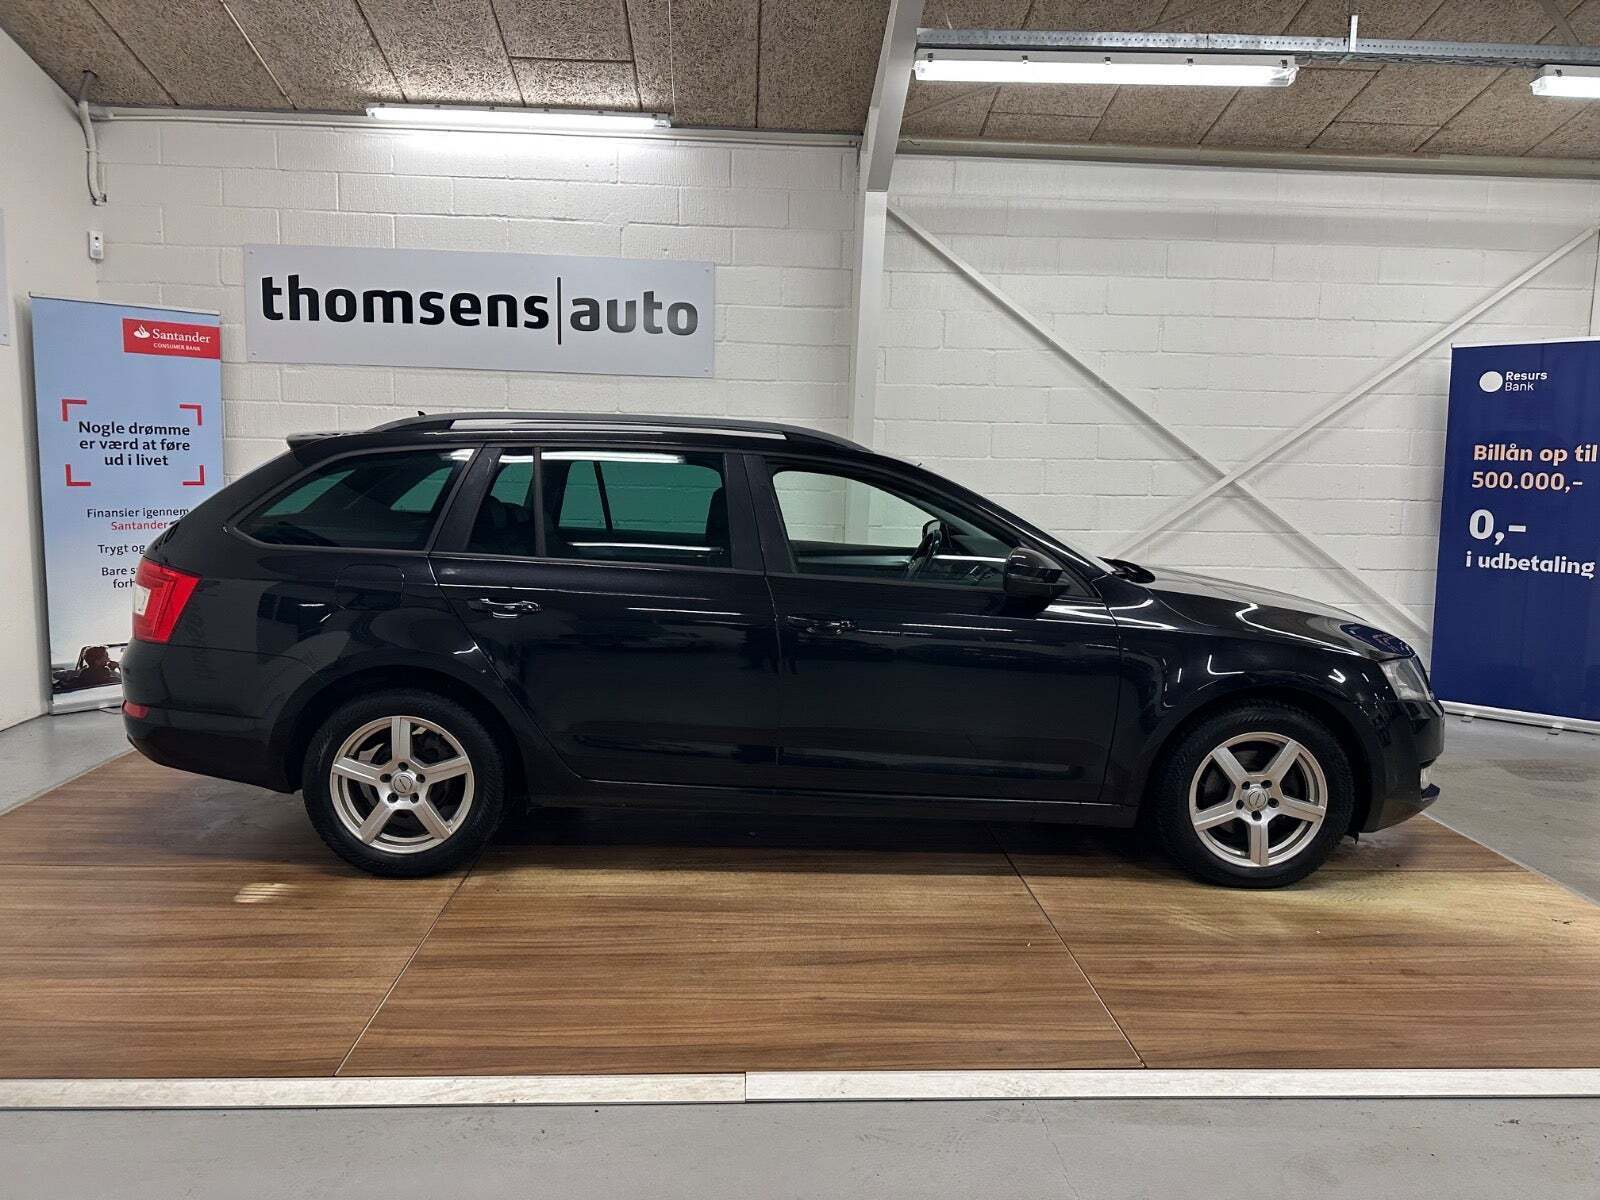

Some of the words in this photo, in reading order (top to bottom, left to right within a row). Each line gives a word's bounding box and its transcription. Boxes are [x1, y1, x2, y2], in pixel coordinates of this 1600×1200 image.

[152, 328, 211, 343] Santander
[153, 342, 185, 350] CONSUMER
[1505, 371, 1548, 381] Resurs
[1504, 381, 1535, 392] Bank
[78, 421, 125, 437] Nogle
[128, 422, 190, 436] drømme
[79, 440, 95, 449] er
[99, 438, 139, 450] værd
[142, 440, 157, 450] at
[160, 438, 190, 451] føre
[104, 453, 124, 466] ud
[128, 454, 132, 466] i
[136, 454, 169, 466] livet
[1473, 443, 1533, 461] Billån
[1539, 448, 1568, 466] op
[1574, 444, 1598, 462] til
[1471, 471, 1583, 493] 500.000,-
[87, 508, 140, 518] Finansier
[143, 508, 189, 519] igennem
[111, 521, 168, 531] Santander
[1469, 509, 1527, 545] 0,-
[97, 544, 128, 556] Trygt
[132, 544, 146, 555] og
[1466, 550, 1472, 567] i
[1478, 552, 1596, 579] udbetaling
[101, 567, 127, 576] Bare
